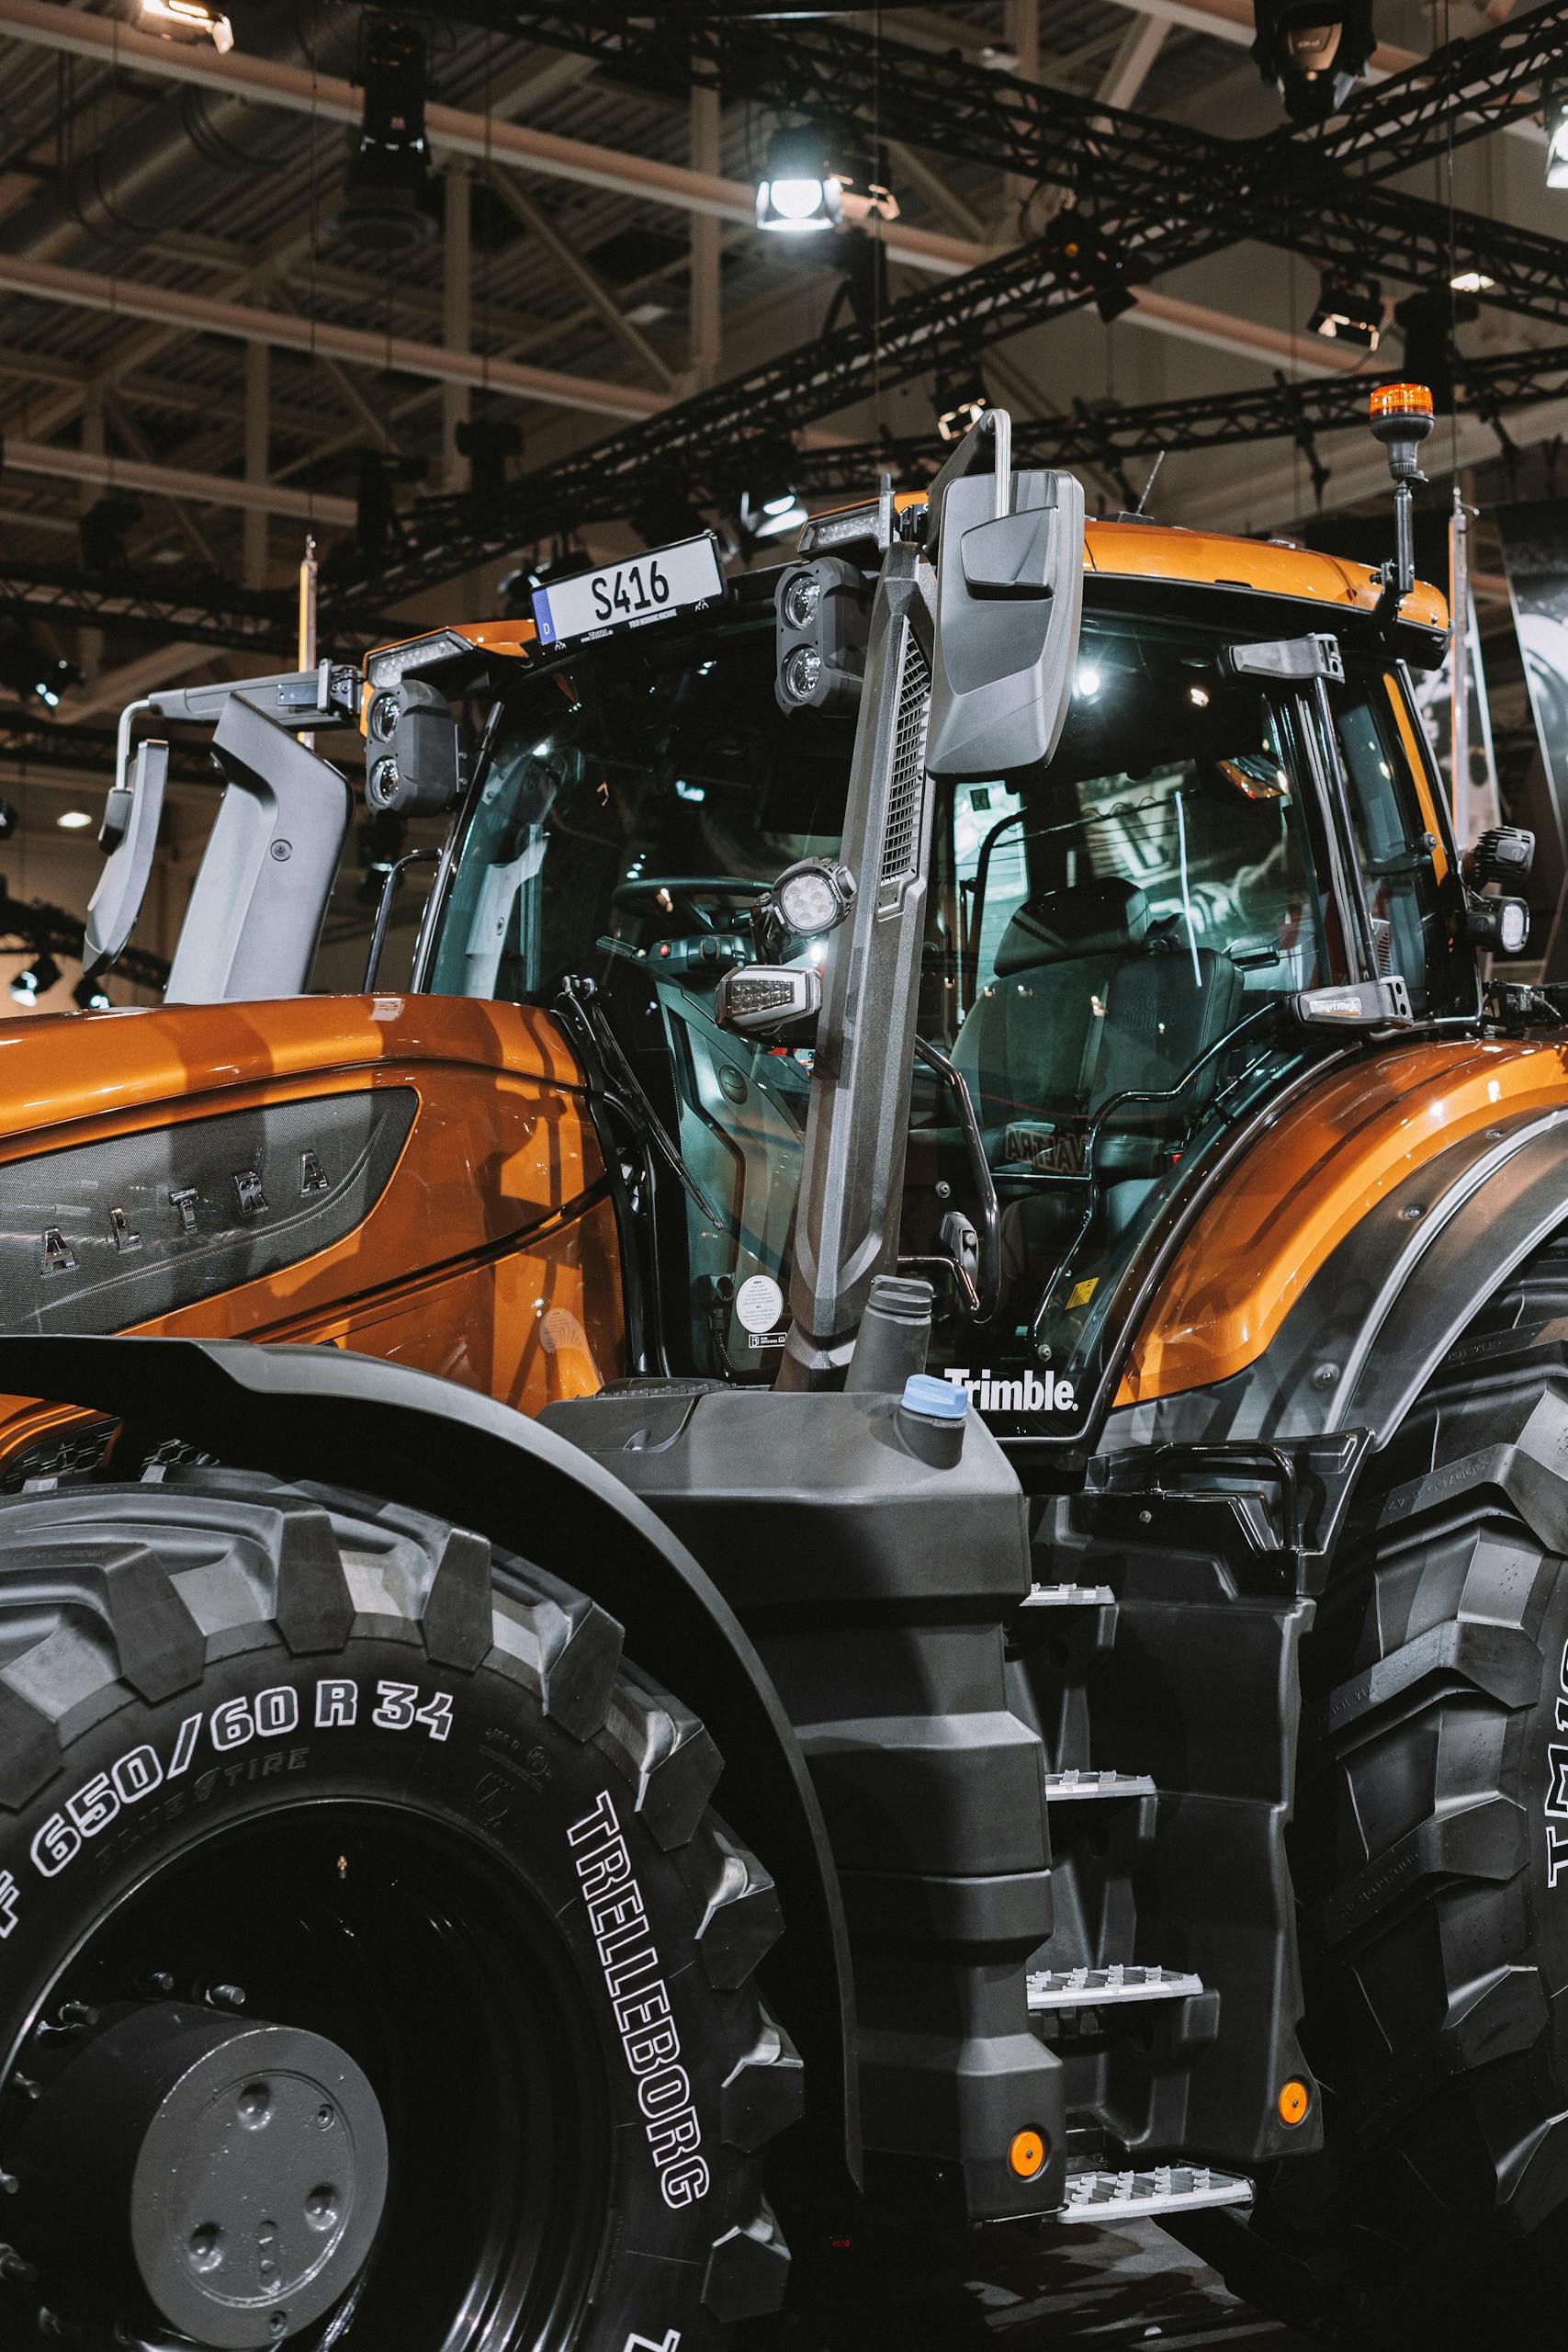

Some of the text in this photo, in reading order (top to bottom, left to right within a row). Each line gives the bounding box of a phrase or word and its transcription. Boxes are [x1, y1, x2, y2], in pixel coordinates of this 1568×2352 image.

[591, 560, 670, 621] S416
[542, 622, 551, 636] D
[30, 1685, 299, 1877] 650/60
[315, 1679, 358, 1727] R
[372, 1679, 454, 1742] 34
[224, 1747, 310, 1788] TIRE
[566, 1790, 711, 2210] TRELLEBORG
